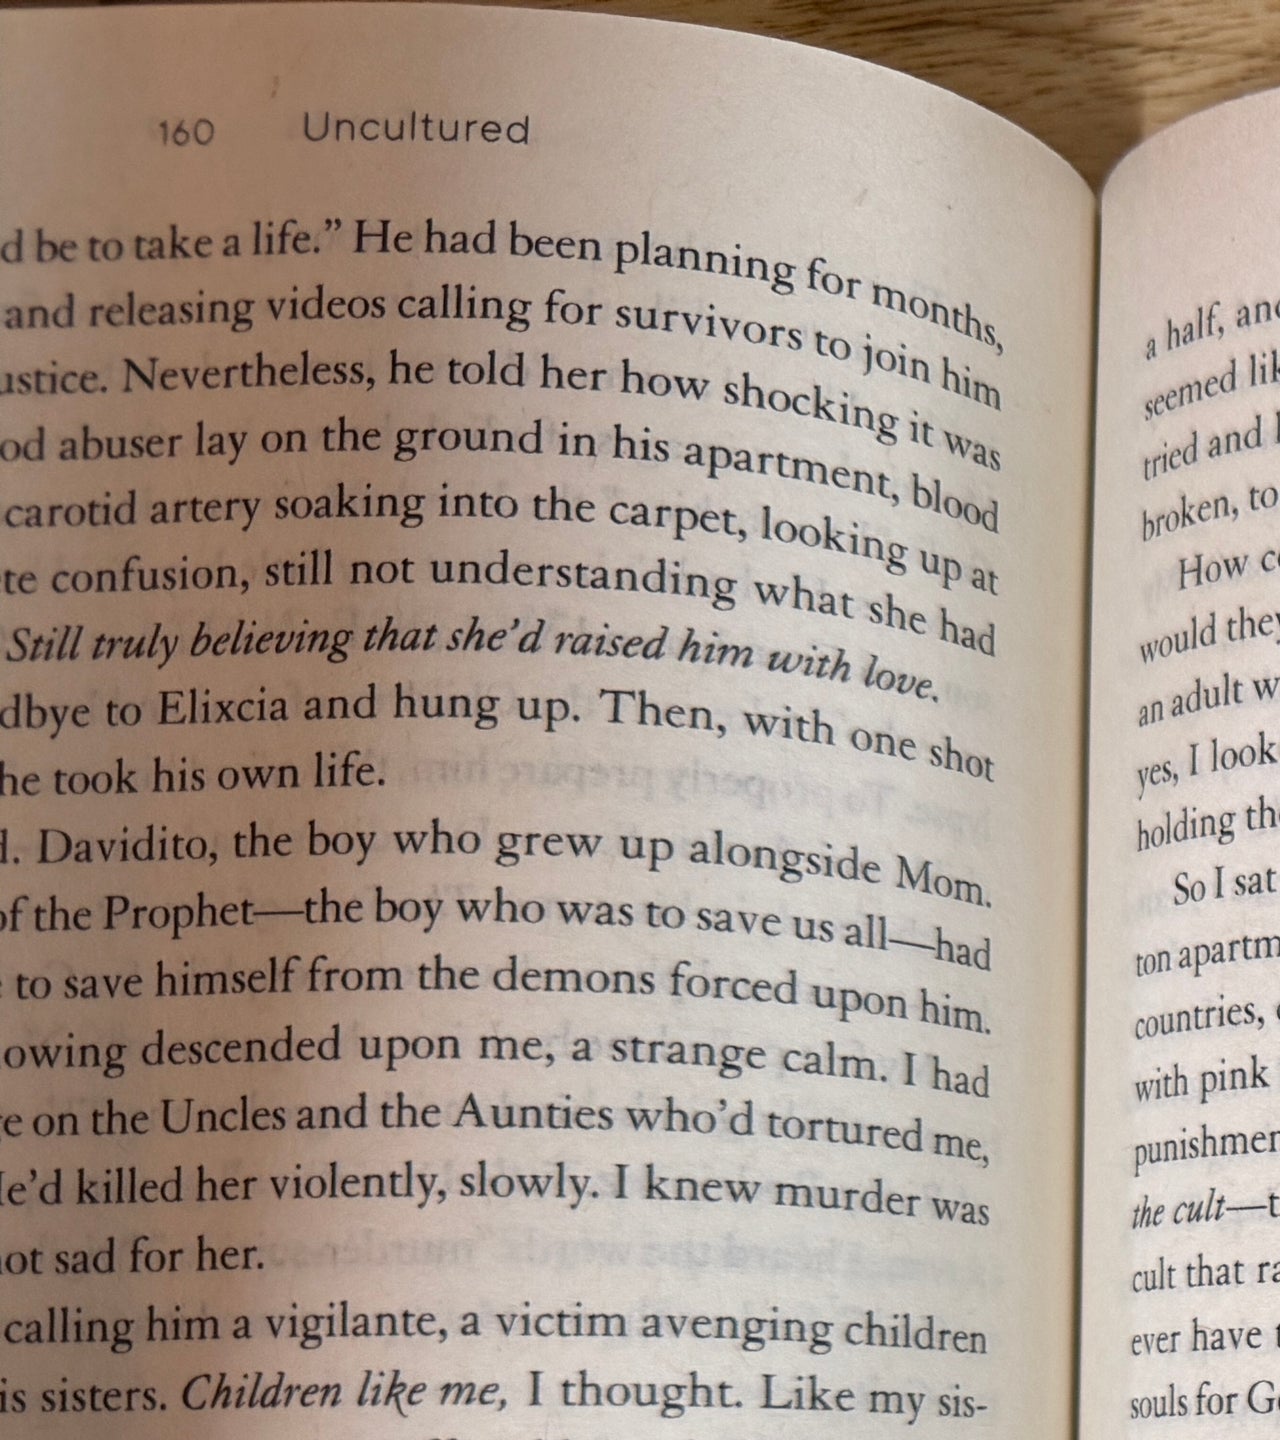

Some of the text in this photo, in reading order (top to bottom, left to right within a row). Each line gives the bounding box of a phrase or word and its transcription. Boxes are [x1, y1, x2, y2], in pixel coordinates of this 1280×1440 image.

[159, 118, 215, 147] 160
[303, 110, 530, 145] Uncultured
[4, 283, 1001, 411] and releasing videos calling for survivors to join him
[1145, 358, 1236, 418] seemed
[1140, 611, 1217, 664] would
[106, 699, 142, 727] to
[157, 687, 289, 725] Elixcia
[303, 682, 377, 721] and
[393, 681, 501, 731] hung
[516, 697, 580, 733] up.
[598, 688, 727, 739] Then,
[743, 708, 836, 746] with
[850, 728, 917, 761] one
[929, 735, 994, 783] shot
[141, 1023, 341, 1066] descended
[359, 1035, 461, 1072] upon
[479, 1035, 555, 1068] me,
[571, 1037, 593, 1062] a
[611, 1036, 767, 1080] strange
[782, 1040, 888, 1083] calm.
[903, 1051, 916, 1086] I
[932, 1055, 990, 1099] had
[1135, 1063, 1189, 1102] with
[1200, 1054, 1271, 1105] pink
[3, 1299, 987, 1356] calling him a vigilante, a victim avenging children
[1131, 1331, 1181, 1356] ever
[1191, 1316, 1262, 1352] have
